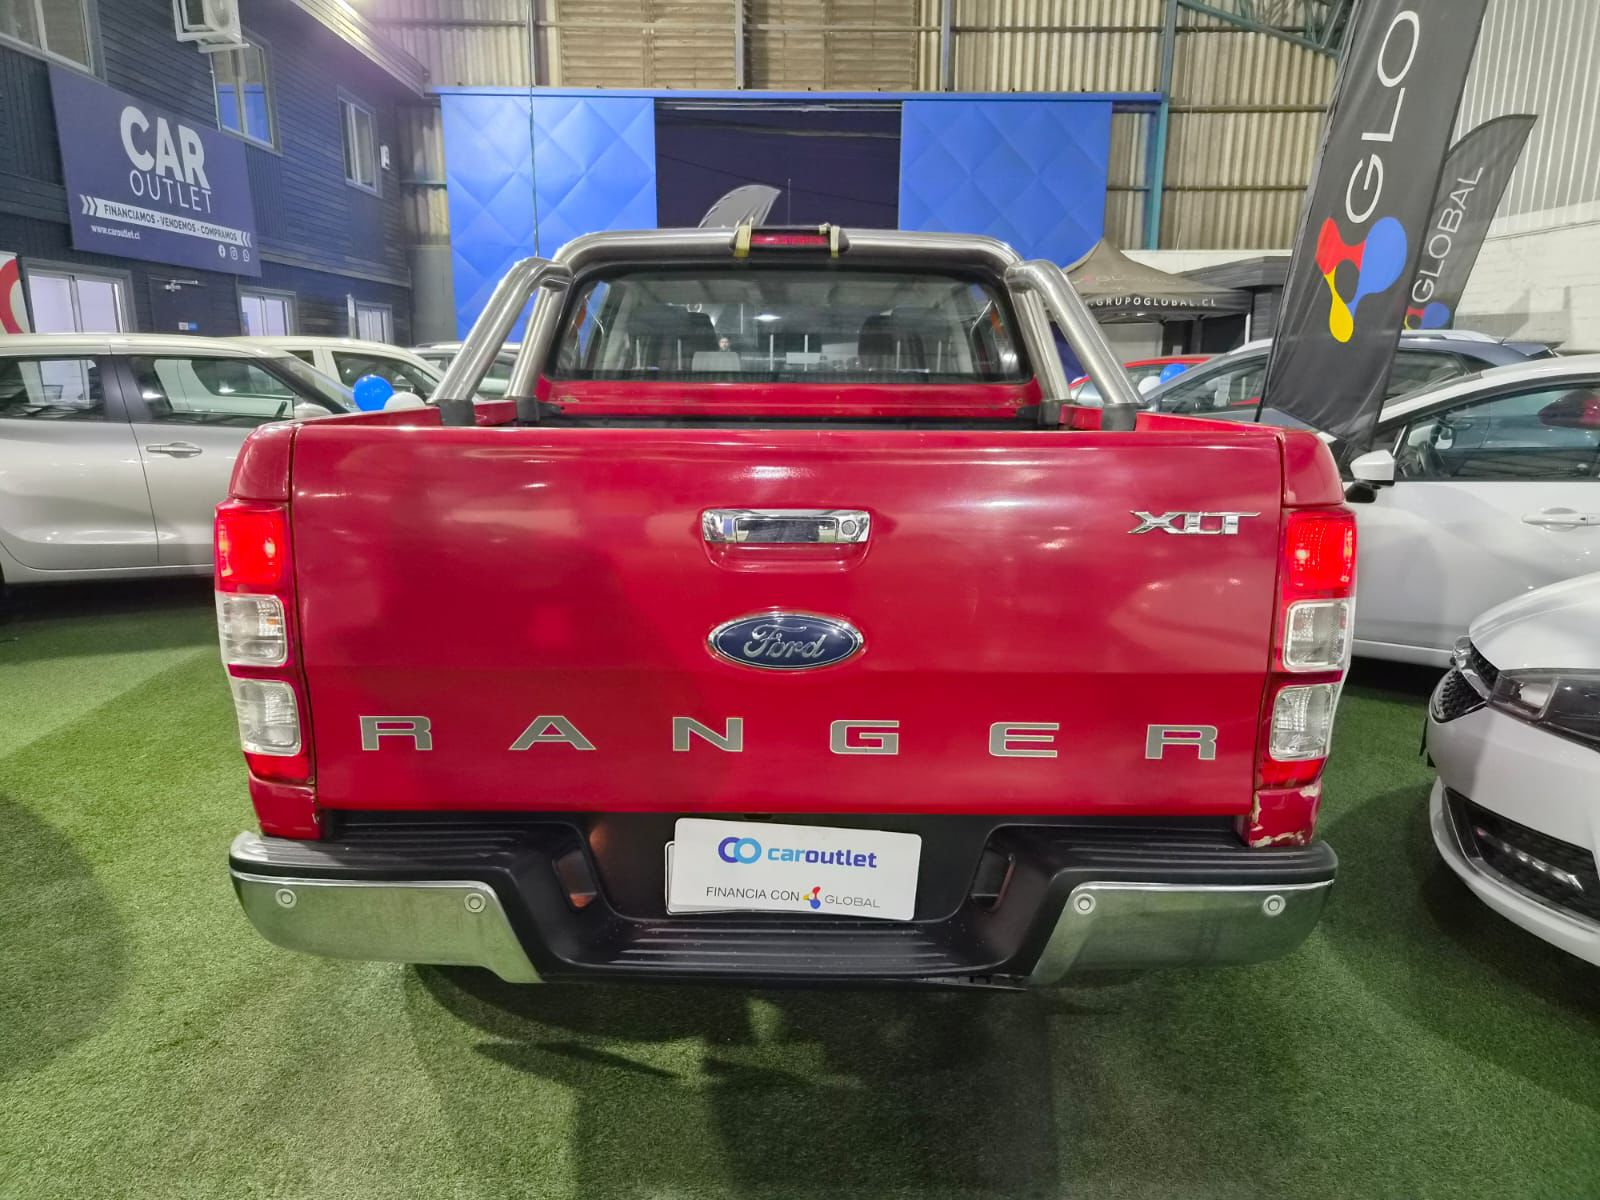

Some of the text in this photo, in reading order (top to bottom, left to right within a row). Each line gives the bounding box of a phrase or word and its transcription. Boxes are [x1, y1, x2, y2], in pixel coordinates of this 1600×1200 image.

[1345, 10, 1420, 223] GLO
[120, 106, 210, 189] CAR
[130, 169, 212, 214] OUTLET
[104, 204, 238, 241] FINANCIAMOS VENDEMOS COMPRAMOS
[1411, 167, 1484, 303] GLOBAL
[1085, 296, 1217, 307] .GRUPOGLOBAL.CL
[1127, 510, 1262, 535] XLT
[743, 624, 828, 658] Ford
[360, 715, 1218, 760] RANGER
[767, 846, 878, 869] caroutlet
[706, 885, 881, 909] FINANCIA CON GLOBAL
